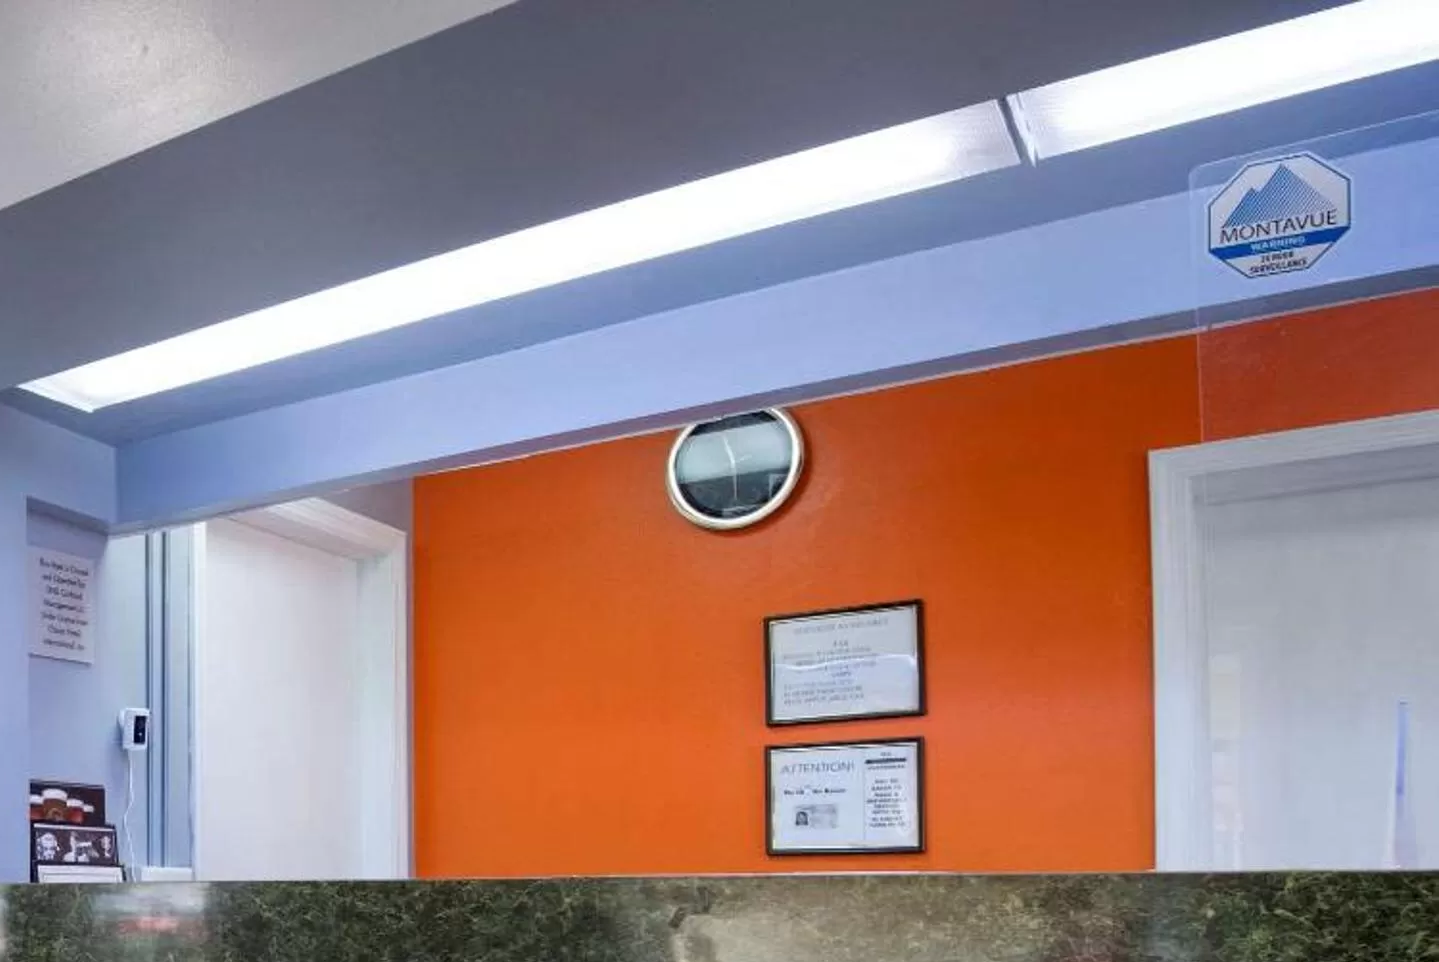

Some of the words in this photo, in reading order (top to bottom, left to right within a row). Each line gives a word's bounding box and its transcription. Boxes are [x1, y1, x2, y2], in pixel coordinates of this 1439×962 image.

[1219, 209, 1337, 244] MONTAVUE
[1250, 235, 1306, 253] WARNING
[780, 761, 854, 775] ATTENTION!
